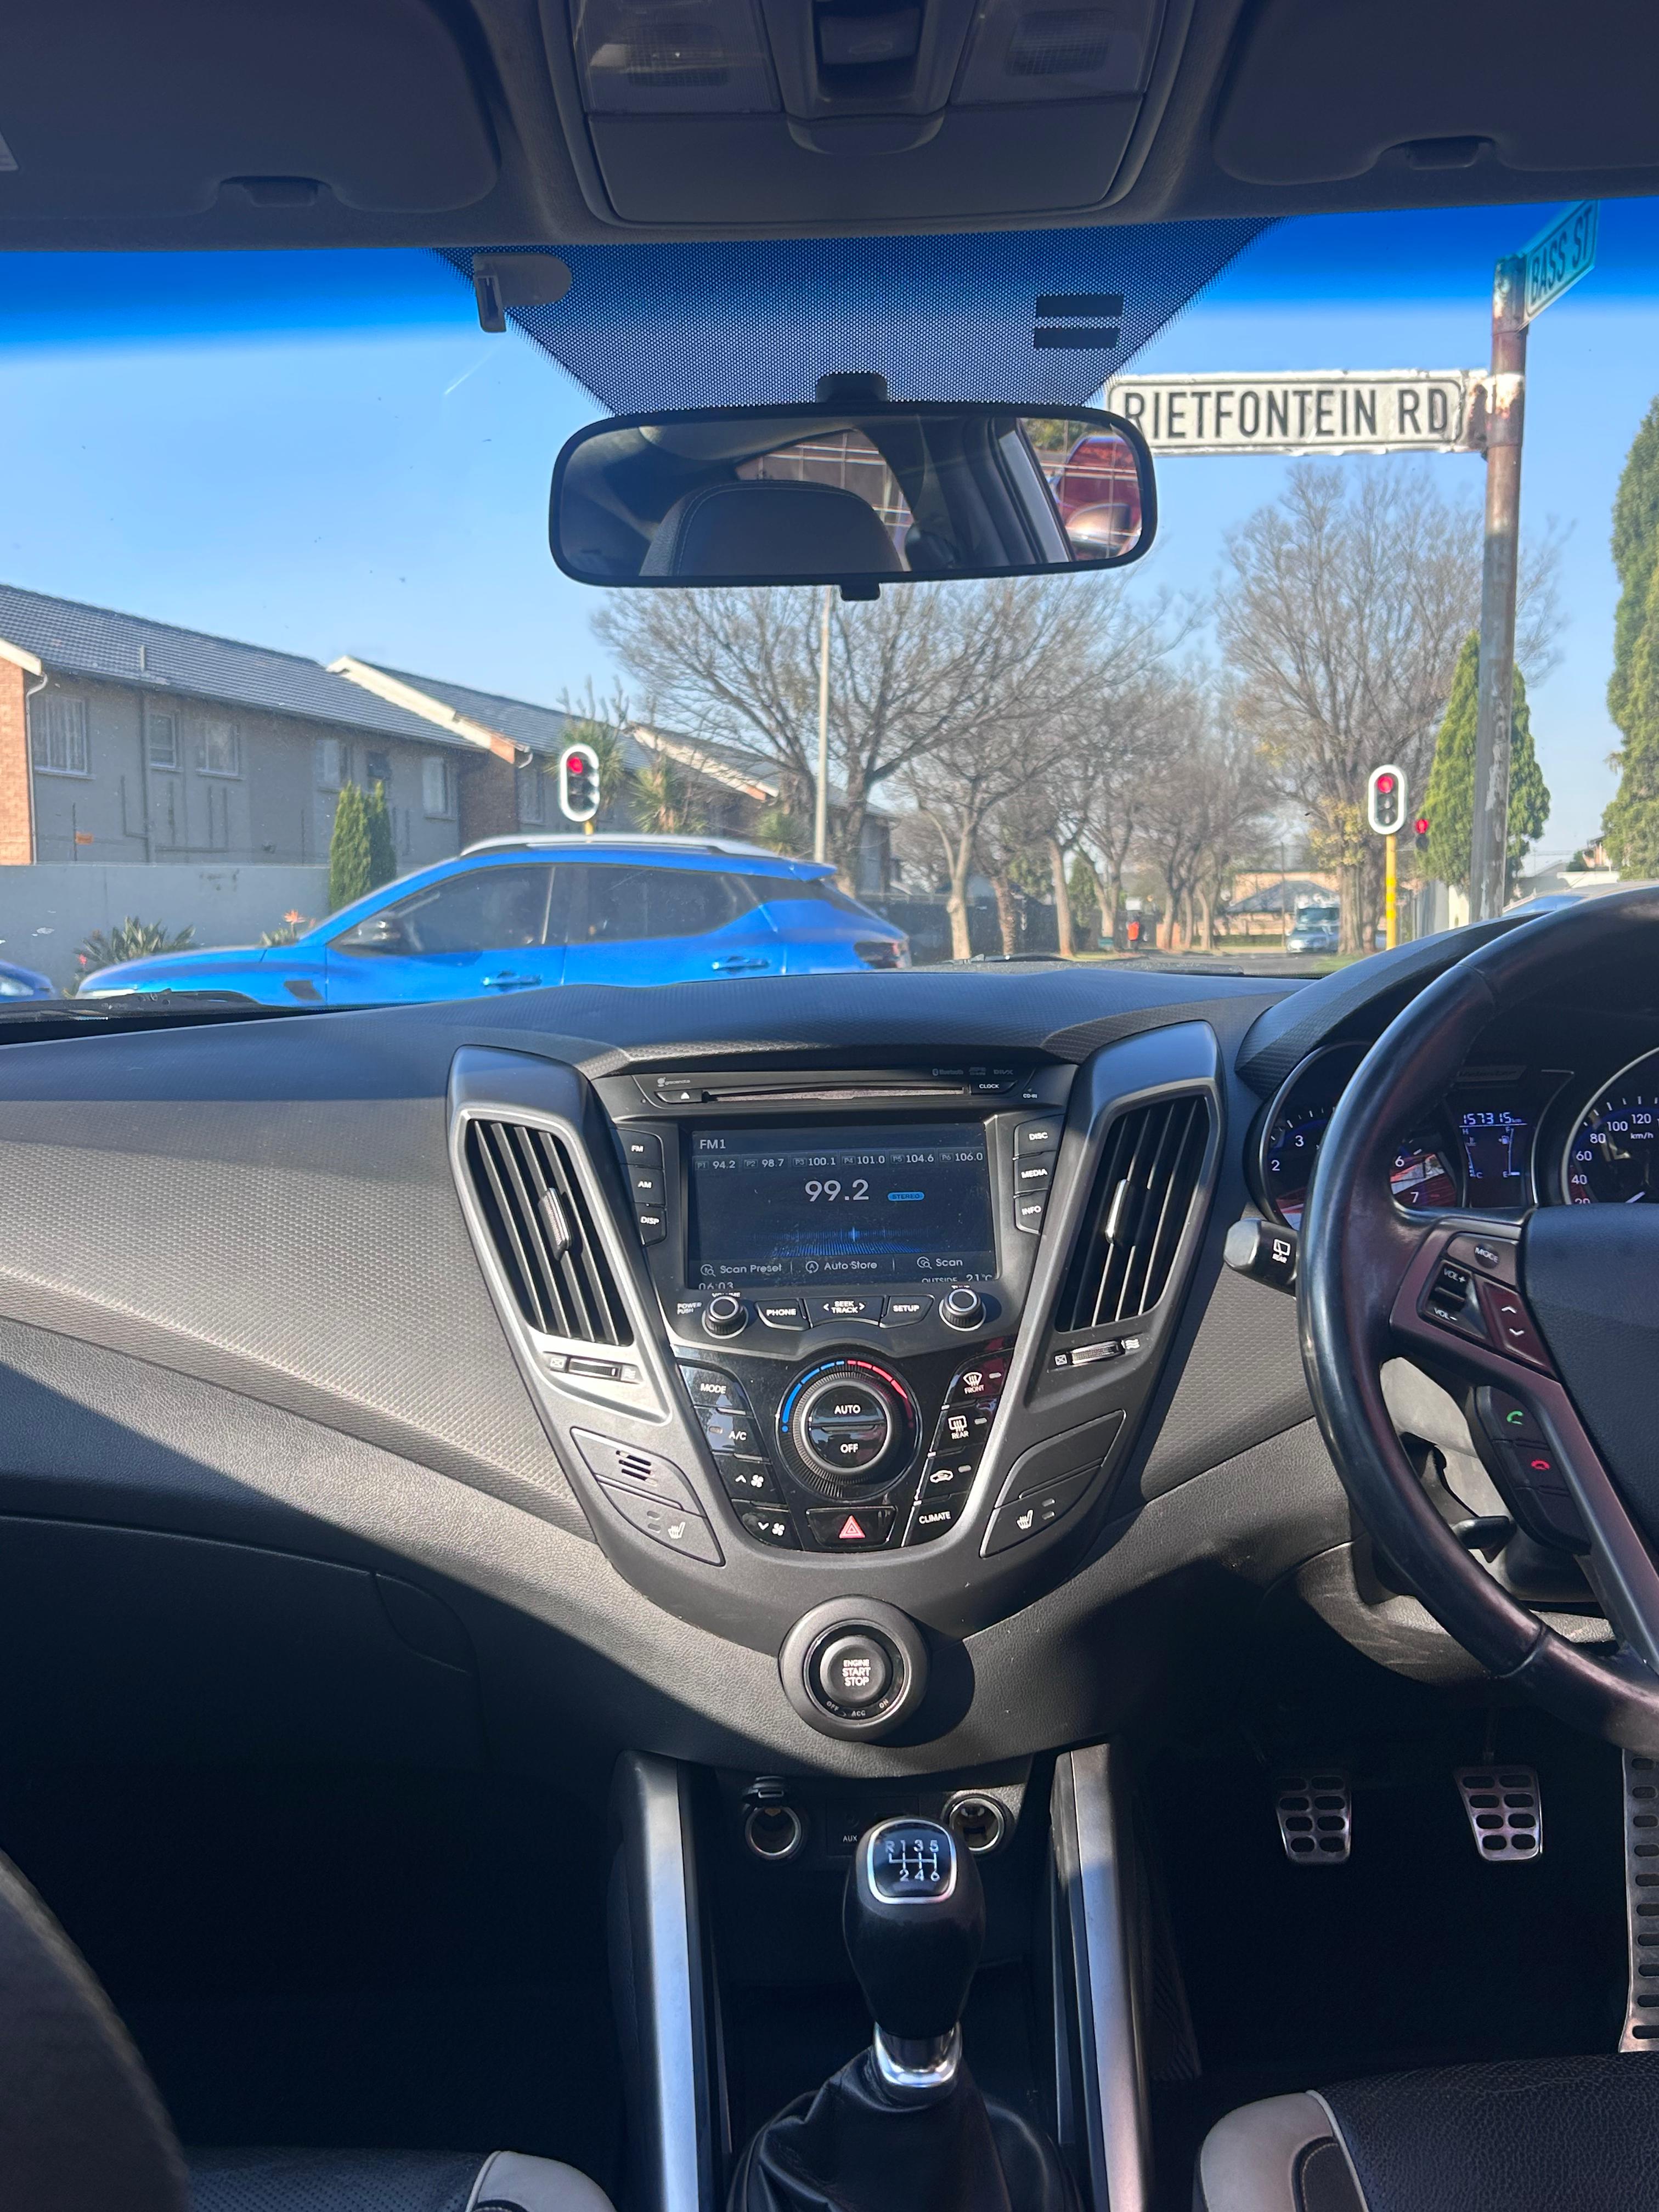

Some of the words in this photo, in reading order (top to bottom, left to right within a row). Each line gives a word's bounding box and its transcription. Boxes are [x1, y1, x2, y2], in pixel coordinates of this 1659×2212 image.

[1572, 204, 1592, 267] ST
[1124, 389, 1376, 441] RIETFONTEIN
[1397, 389, 1448, 435] RD
[1632, 1113, 1651, 1124] 120
[1607, 1121, 1628, 1131] 100
[1029, 1132, 1048, 1141] DISC
[1295, 1135, 1304, 1147] 3
[1590, 1133, 1606, 1143] 80
[699, 1139, 726, 1149] FM1
[713, 1160, 736, 1170] 94.2
[761, 1158, 784, 1167] 98.7
[809, 1157, 836, 1166] 100.1
[857, 1155, 885, 1164] 101.0
[906, 1154, 934, 1163] 104.6
[955, 1152, 983, 1162] 106.0
[1576, 1150, 1592, 1161] 60
[1271, 1160, 1280, 1171] 2
[1395, 1156, 1404, 1167] 6
[1021, 1169, 1048, 1178] MEDIA
[1571, 1175, 1587, 1184] 40
[805, 1179, 869, 1201] 99.2
[1410, 1192, 1419, 1203] 7
[1022, 1205, 1041, 1215] INFO
[641, 1216, 659, 1225] DISP
[720, 1264, 747, 1274] Scan
[750, 1263, 782, 1273] Preset
[824, 1262, 849, 1271] Auto
[851, 1261, 877, 1270] Store
[936, 1259, 963, 1267] Scan
[766, 1308, 797, 1317] PHONE
[700, 1384, 727, 1395] MODE
[964, 1382, 985, 1394] FRONT
[834, 1404, 861, 1415] AUTO
[728, 1431, 747, 1442] A/C
[951, 1429, 969, 1440] REAR
[840, 1442, 859, 1454] OFF
[918, 1511, 951, 1526] CLIMATE
[842, 1667, 871, 1677] START
[844, 1677, 869, 1686] STOP
[826, 1701, 839, 1711] OFF
[879, 1699, 889, 1709] ON
[885, 1840, 895, 1853] R
[900, 1839, 905, 1852] 1
[913, 1839, 923, 1852] 3
[929, 1839, 939, 1852] 5
[900, 1869, 909, 1882] 2
[915, 1869, 924, 1882] 4
[930, 1870, 940, 1882] 6
